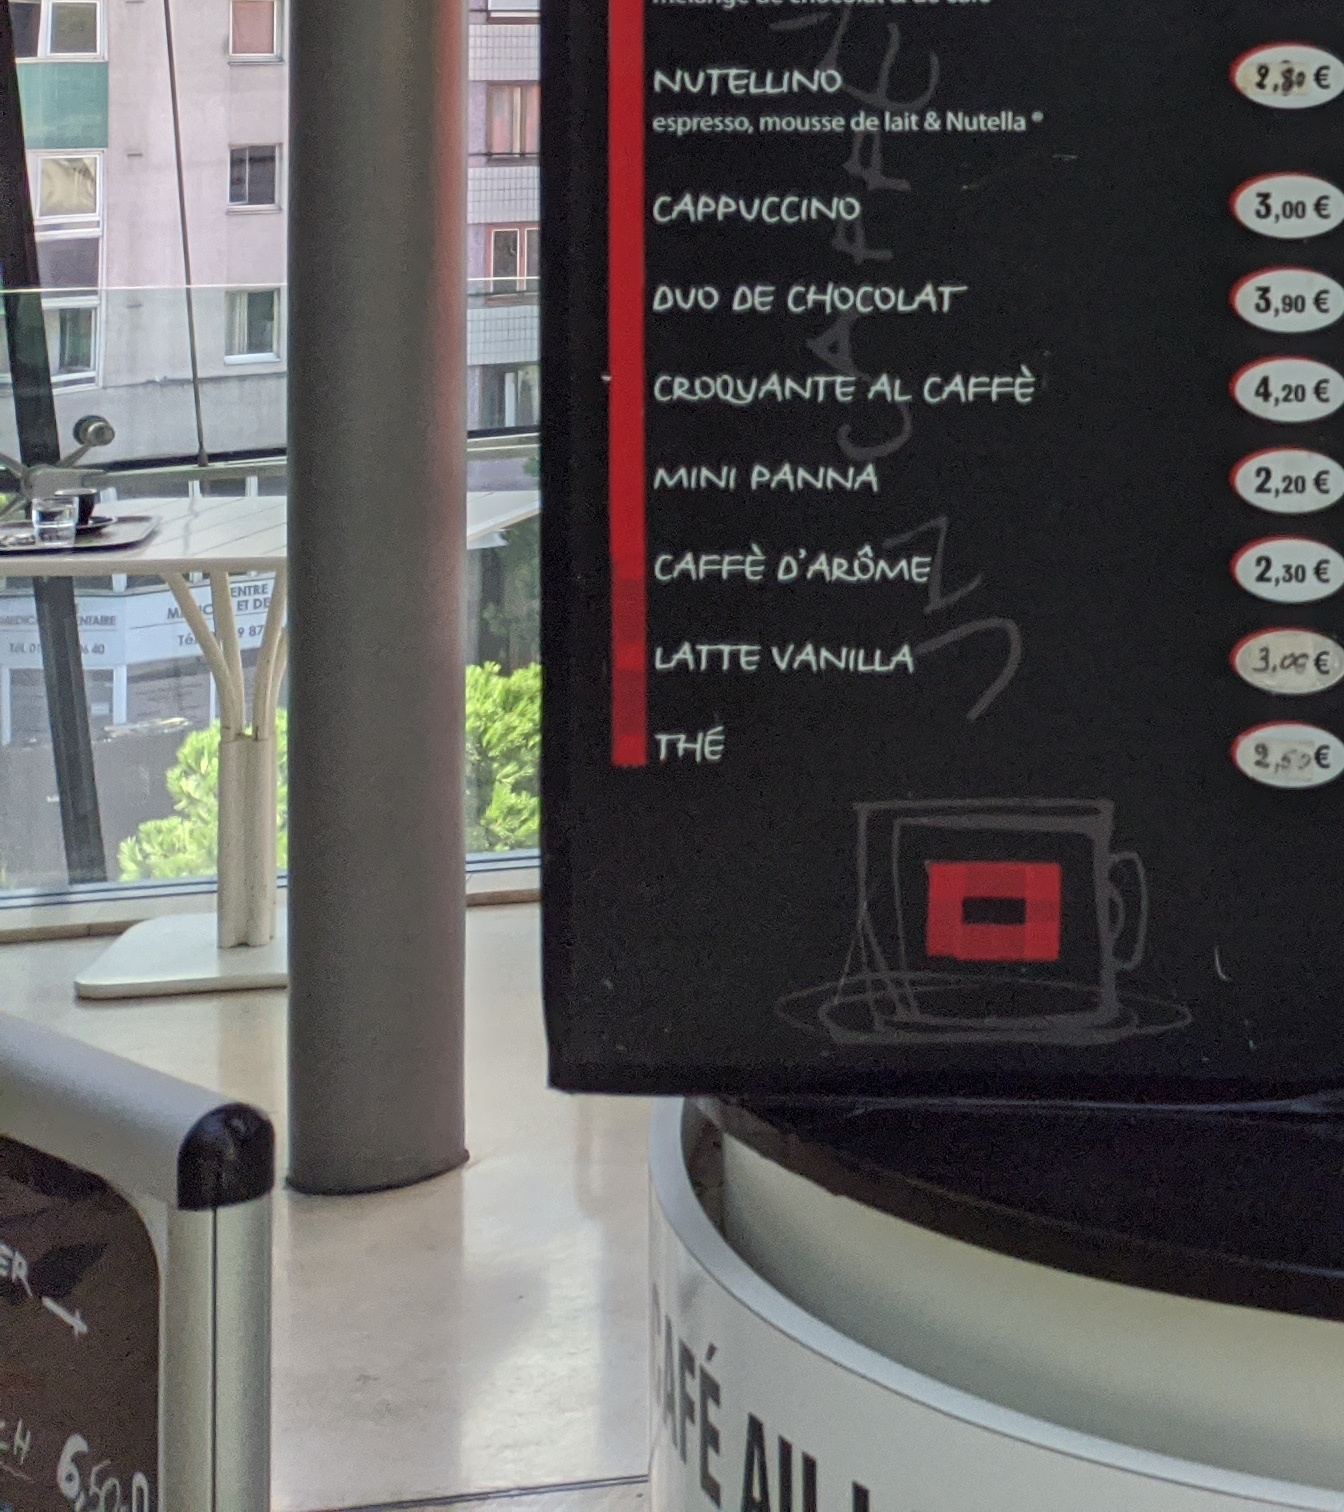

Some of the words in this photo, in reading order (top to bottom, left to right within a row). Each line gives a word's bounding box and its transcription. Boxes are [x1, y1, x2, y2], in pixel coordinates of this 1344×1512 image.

[653, 67, 843, 95] NUTELLINO
[1313, 64, 1331, 90] €
[652, 116, 754, 136] espresso,
[759, 116, 846, 132] mousse
[850, 110, 880, 133] de
[884, 110, 919, 132] lait
[923, 110, 941, 131] &
[652, 193, 861, 224] CAPPUCCINO
[1254, 191, 1307, 223] 3,00
[1312, 194, 1331, 220] €
[652, 285, 720, 312] DUO
[732, 284, 775, 312] DE
[787, 282, 968, 314] CHOCOLAT
[1254, 285, 1307, 317] 3,90
[1312, 288, 1330, 314] €
[653, 373, 856, 406] CROQUANTE
[867, 373, 912, 403] AL
[923, 364, 1035, 404] CAFFÈ
[1254, 375, 1307, 407] 4,20
[1312, 378, 1330, 404] €
[653, 465, 737, 489] MINI
[750, 462, 878, 492] PANNA
[1254, 465, 1307, 498] 2,20
[1312, 469, 1331, 495] €
[654, 543, 766, 581] CAFFÈ
[777, 544, 931, 583] D'ARÔME
[1254, 555, 1307, 587] 2,30
[1312, 558, 1331, 584] €
[654, 641, 761, 671] LATTE
[771, 643, 914, 673] VANILLA
[1313, 649, 1331, 676] €
[655, 725, 724, 762] THÉ
[1313, 744, 1331, 770] €
